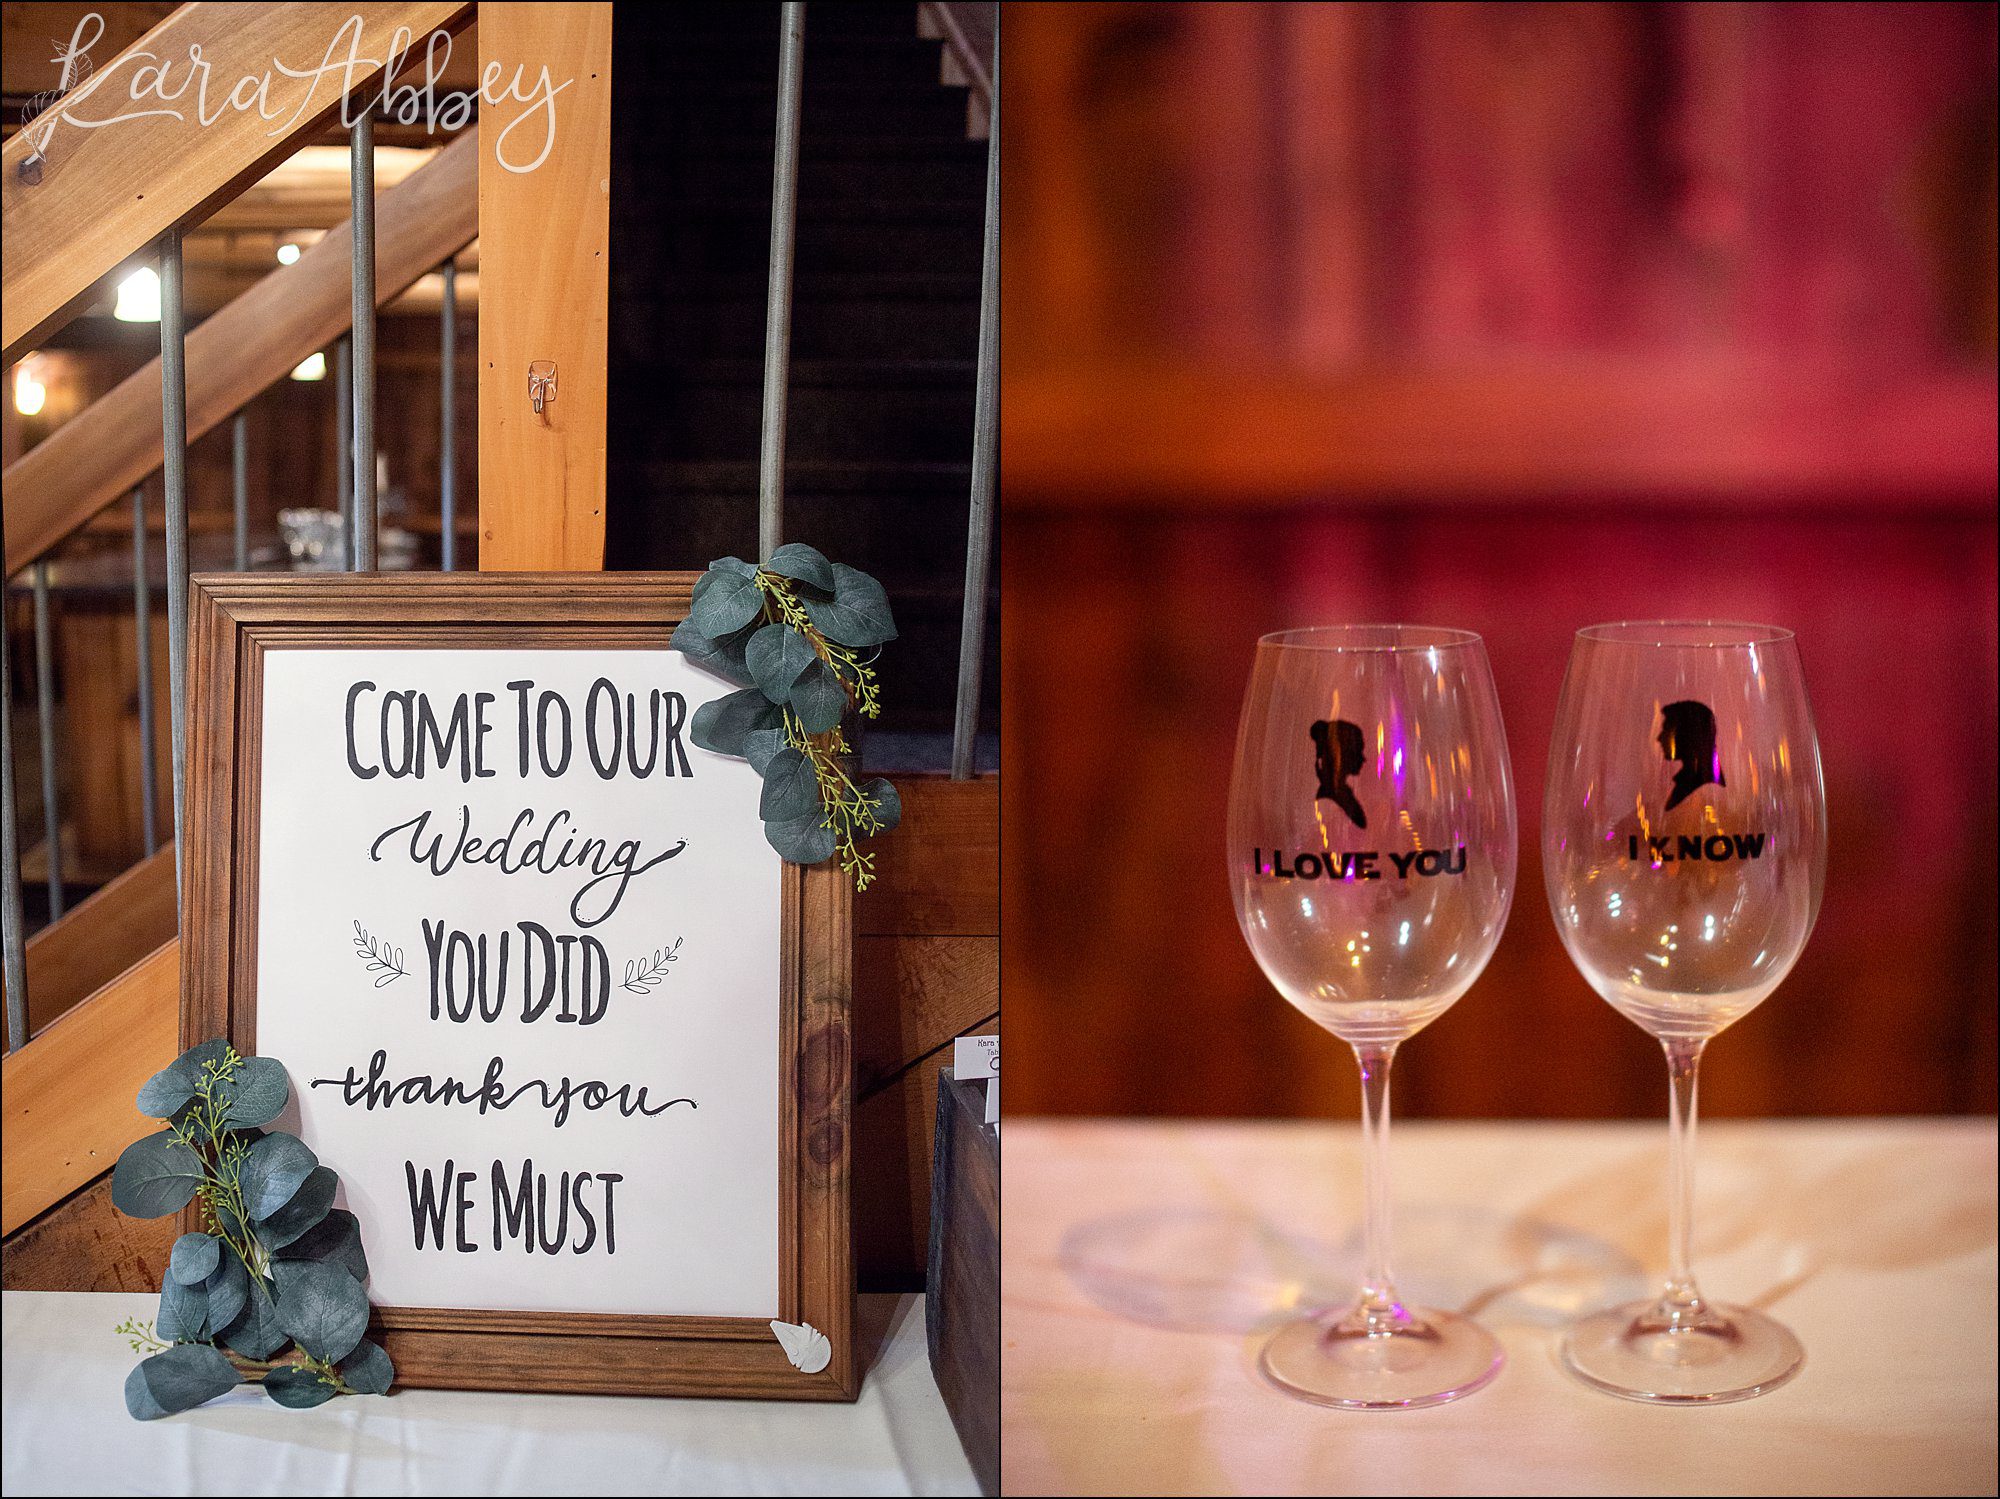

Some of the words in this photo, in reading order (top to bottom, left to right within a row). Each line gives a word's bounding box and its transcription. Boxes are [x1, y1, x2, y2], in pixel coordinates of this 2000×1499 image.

[506, 680, 572, 778] TO
[585, 677, 693, 780] OUR
[370, 805, 686, 928] Wedding
[1254, 847, 1261, 875] I
[1273, 849, 1380, 879] LOVE
[1389, 847, 1467, 879] YOU
[1629, 834, 1638, 861] I
[1649, 833, 1765, 862] KNOW
[421, 918, 509, 1023] YOU
[516, 921, 611, 1025] DID
[310, 1049, 522, 1115] thank
[522, 1077, 697, 1128] you
[405, 1159, 478, 1253] WE
[491, 1159, 623, 1255] MUST
